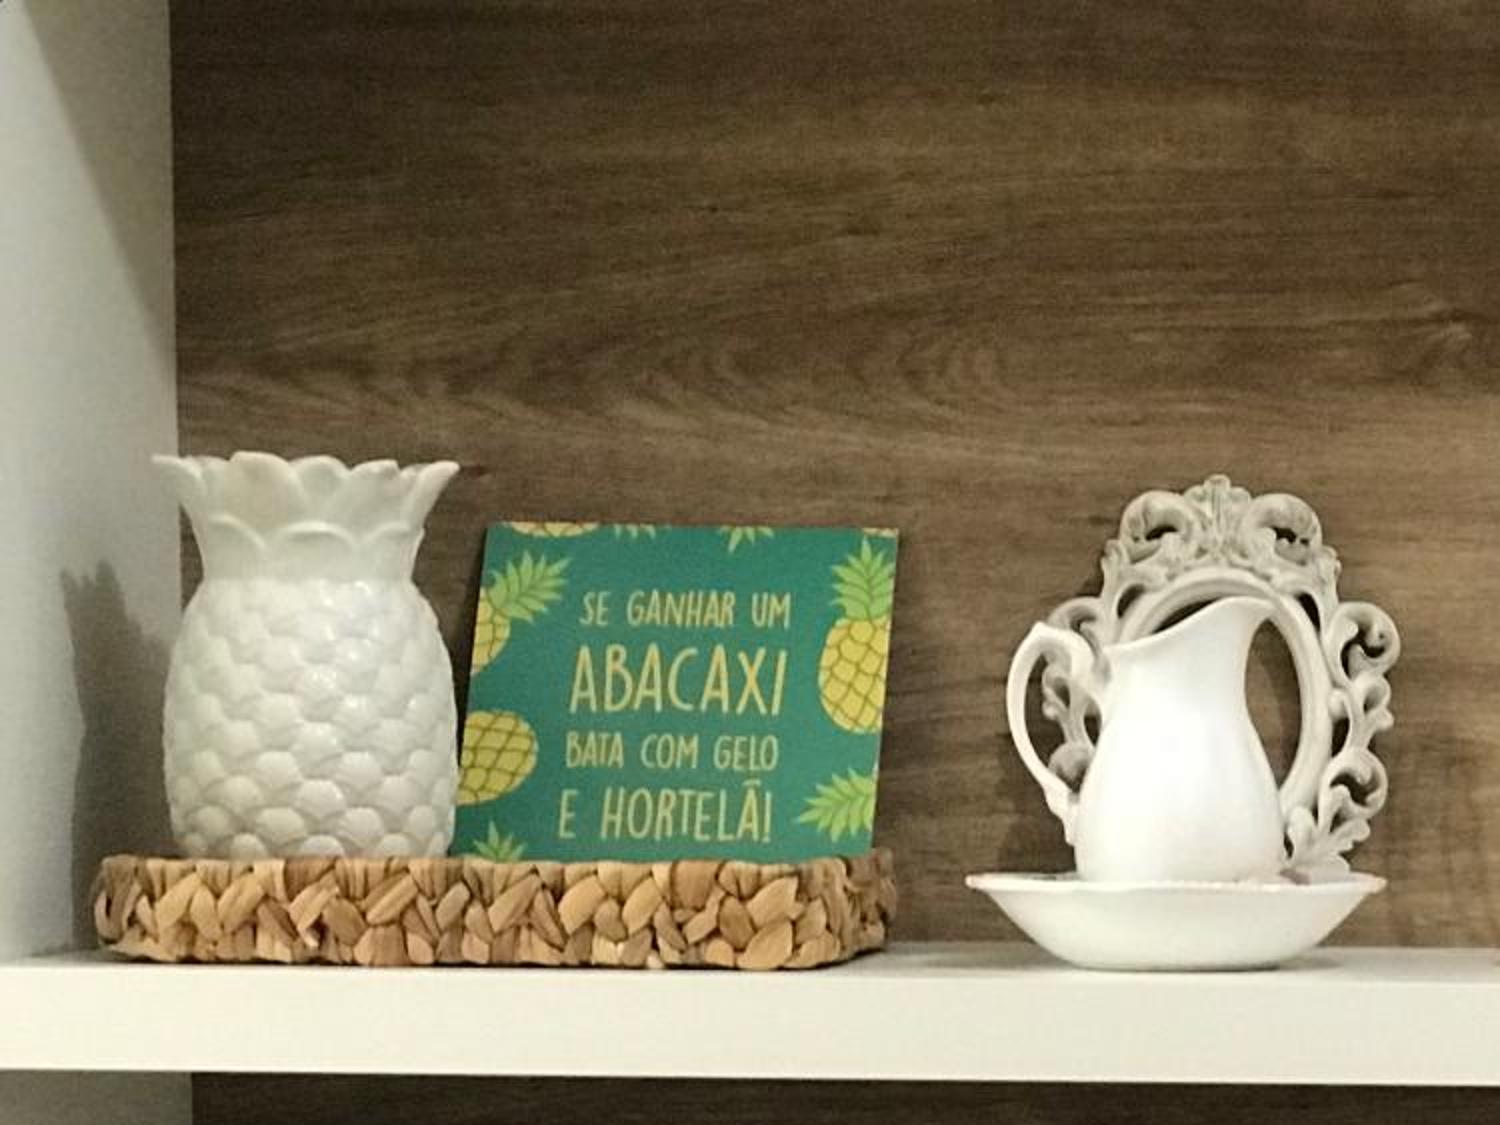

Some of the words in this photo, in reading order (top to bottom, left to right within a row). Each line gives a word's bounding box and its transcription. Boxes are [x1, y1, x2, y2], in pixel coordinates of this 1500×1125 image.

[579, 591, 610, 626] SE
[627, 589, 736, 628] GANHAR
[752, 592, 791, 627] UM
[569, 643, 787, 716] ABACAXI
[566, 731, 625, 769] BATA
[640, 733, 698, 769] COM
[714, 735, 778, 771] GELO
[559, 789, 578, 839] E
[601, 779, 773, 844] HORTELÃ!
